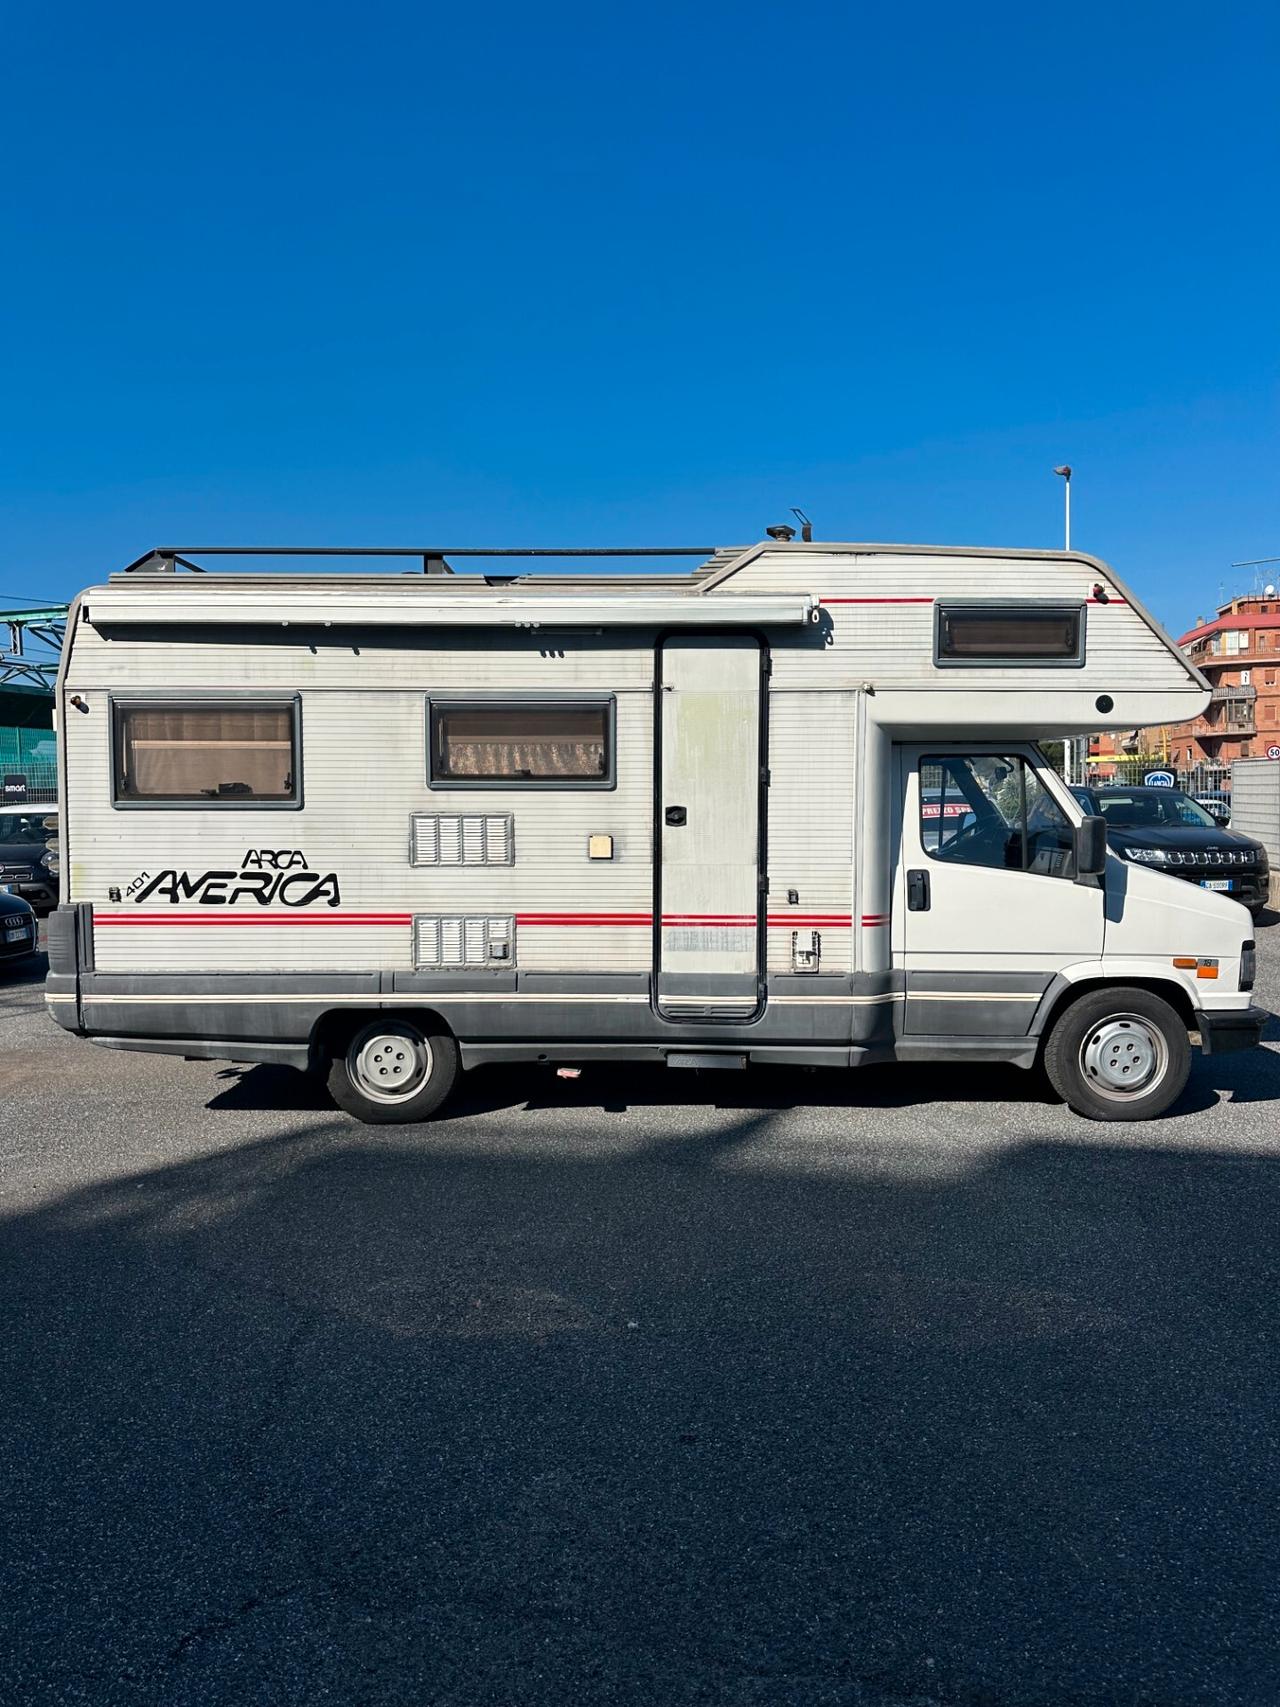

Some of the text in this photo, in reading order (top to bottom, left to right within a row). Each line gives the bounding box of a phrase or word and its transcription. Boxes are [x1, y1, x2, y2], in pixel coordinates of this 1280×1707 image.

[5, 784, 26, 793] smart
[241, 849, 308, 870] ARCA
[126, 871, 150, 897] 401
[134, 870, 341, 907] AMERICA
